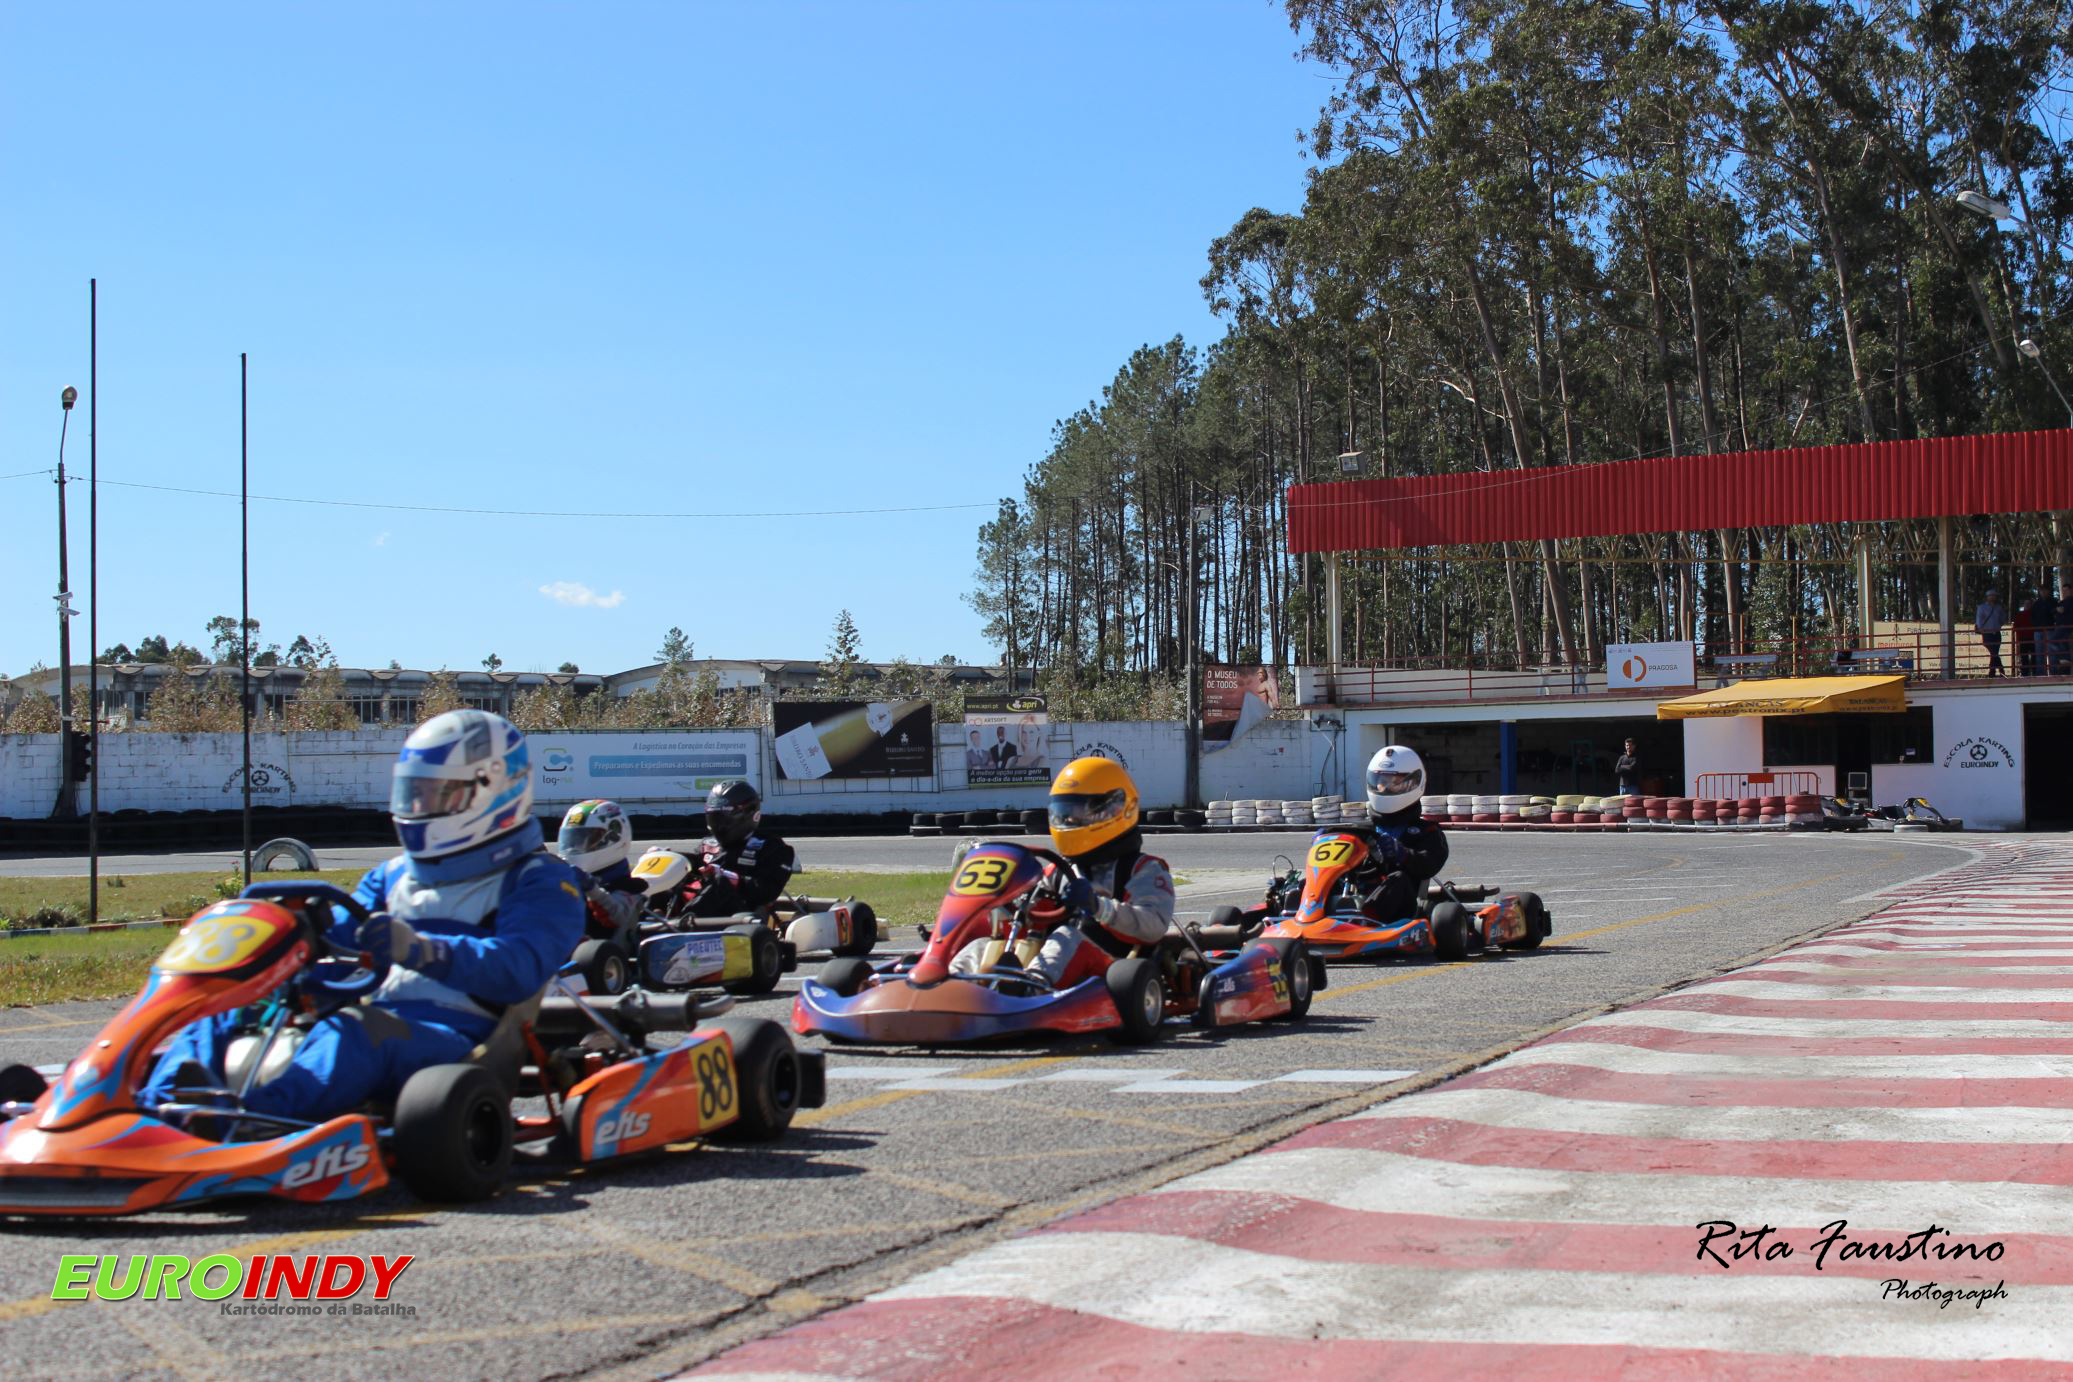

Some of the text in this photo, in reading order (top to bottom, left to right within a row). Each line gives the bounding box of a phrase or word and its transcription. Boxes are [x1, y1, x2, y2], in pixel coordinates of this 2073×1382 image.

[1207, 670, 1238, 679] O MUSEU
[1206, 680, 1238, 689] DE TODOS
[1022, 701, 1037, 709] apri
[716, 741, 746, 751] Empresas
[1943, 736, 2016, 768] ESCOLA KARTING
[1960, 760, 1999, 769] EUROINDY
[1315, 842, 1351, 862] 67
[643, 857, 661, 873] 9
[955, 860, 1008, 890] 63
[163, 922, 257, 966] 88
[697, 1045, 733, 1120] 88
